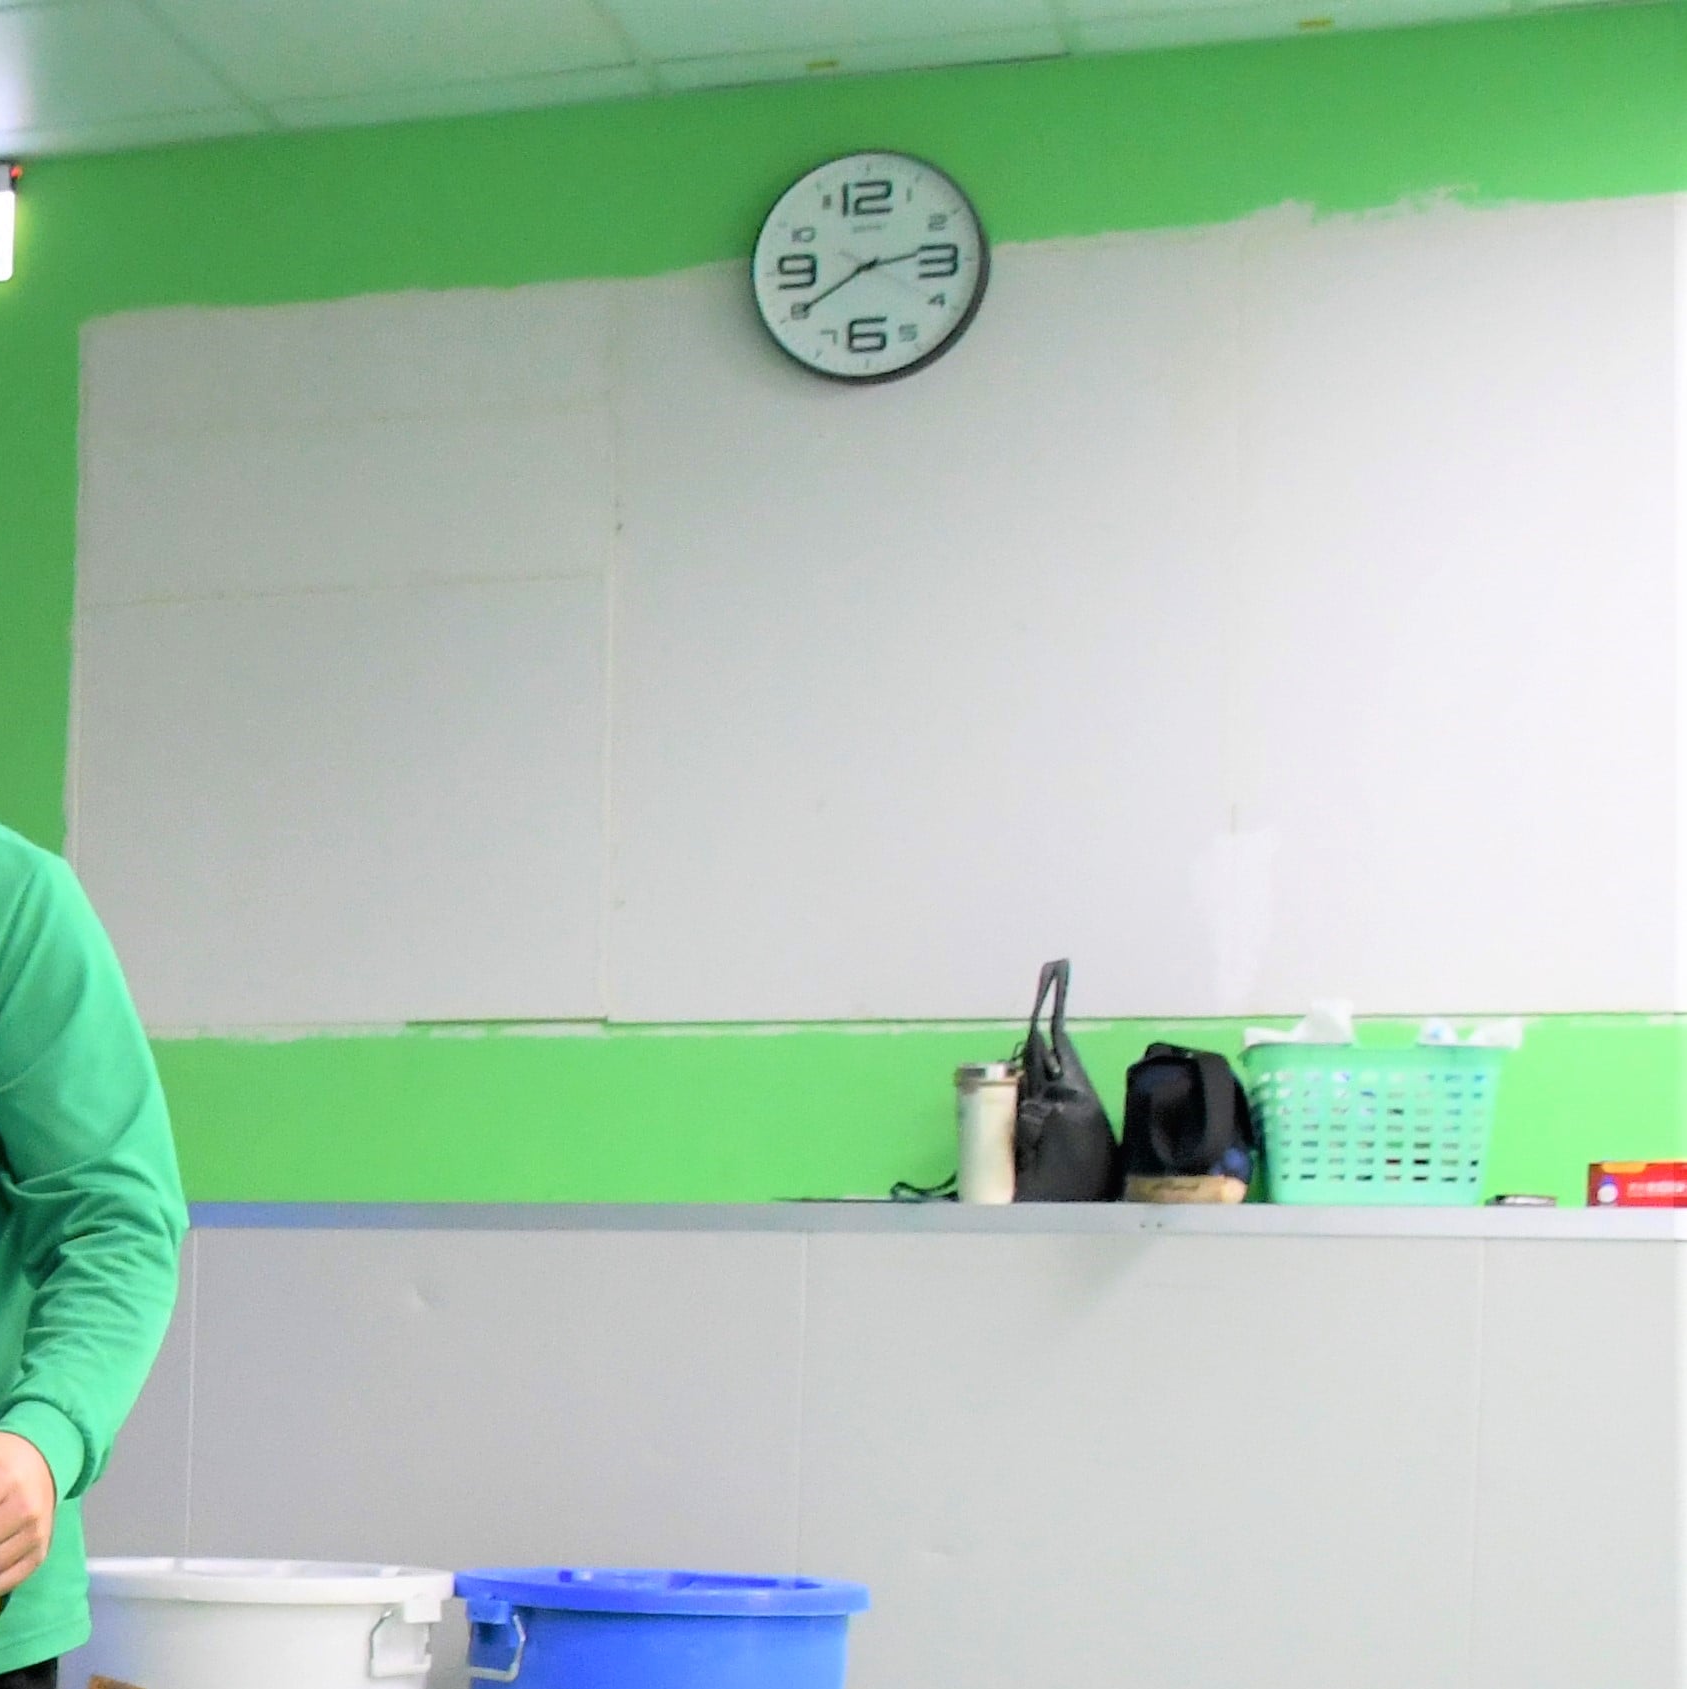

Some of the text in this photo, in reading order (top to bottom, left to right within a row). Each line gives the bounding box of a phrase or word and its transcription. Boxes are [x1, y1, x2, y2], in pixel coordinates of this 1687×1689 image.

[842, 180, 894, 217] 12
[791, 226, 817, 243] 10
[928, 212, 947, 231] 2
[778, 253, 817, 291] 9
[918, 243, 959, 279] 3
[928, 292, 947, 308] 4
[847, 315, 888, 354] 6
[899, 323, 919, 343] 5
